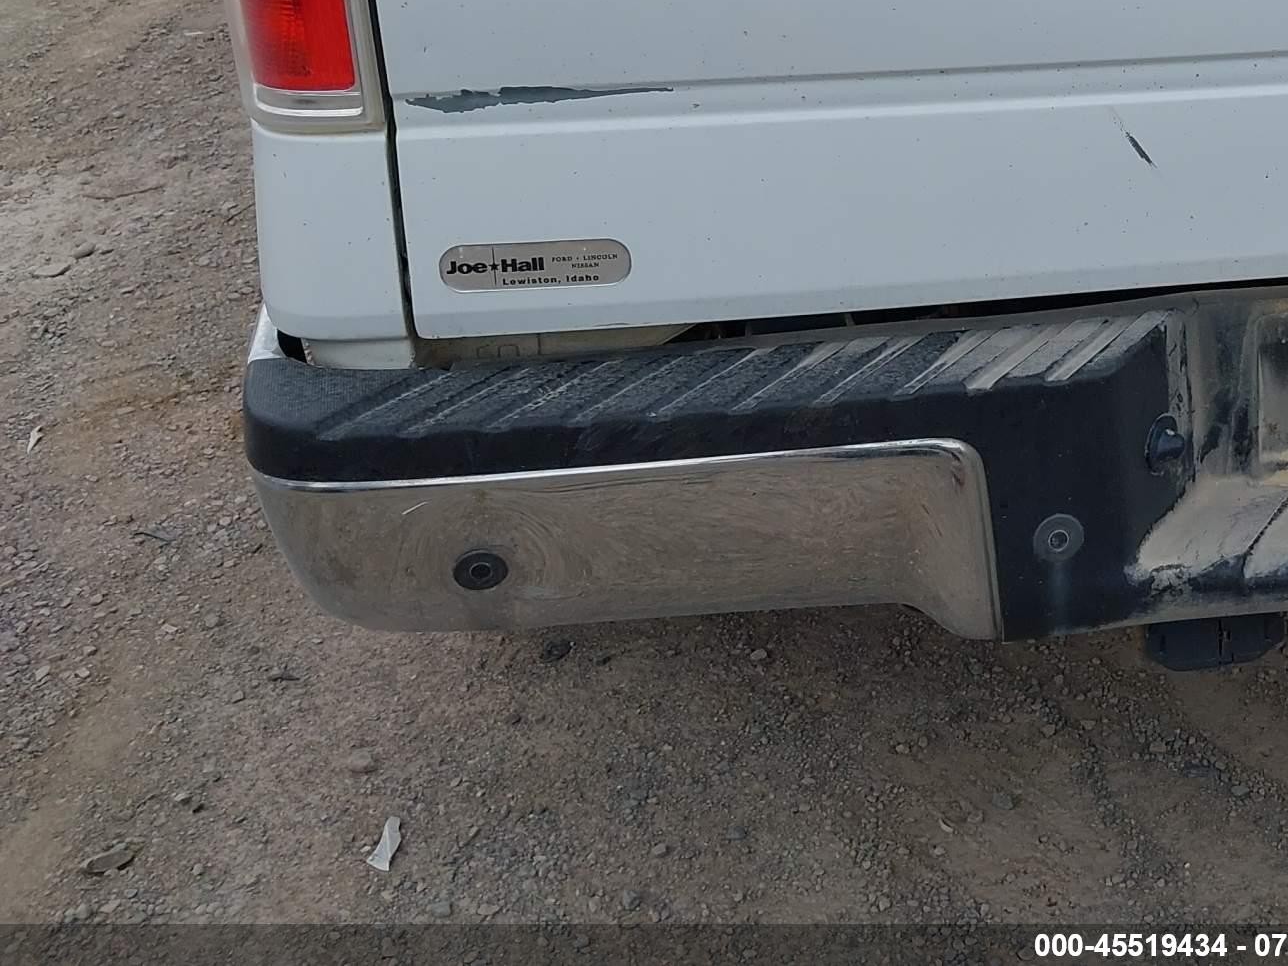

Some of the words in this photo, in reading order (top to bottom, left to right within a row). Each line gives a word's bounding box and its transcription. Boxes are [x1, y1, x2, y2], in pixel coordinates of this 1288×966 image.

[446, 260, 487, 275] Joe
[501, 257, 545, 273] Hall
[502, 276, 561, 286] Lewiston,
